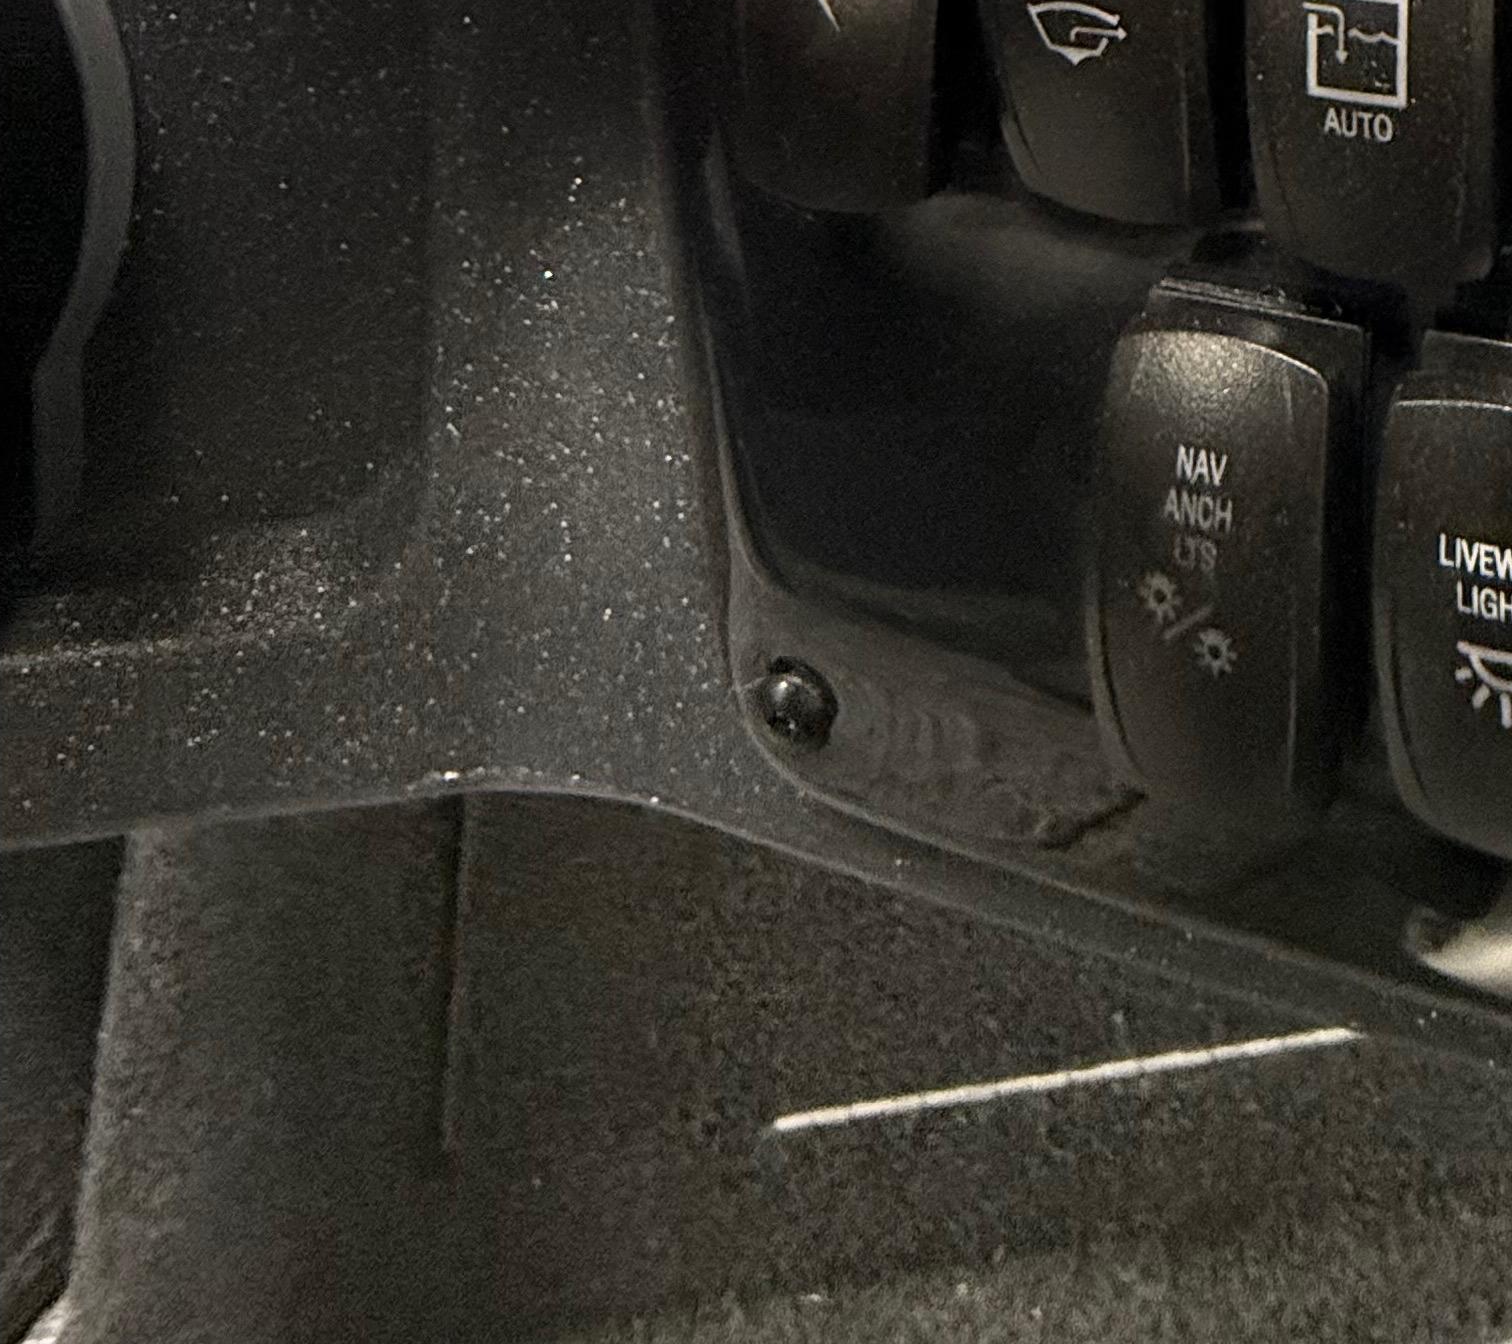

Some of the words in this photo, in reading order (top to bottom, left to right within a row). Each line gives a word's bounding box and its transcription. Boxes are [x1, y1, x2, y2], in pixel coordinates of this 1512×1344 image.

[1324, 107, 1395, 143] AUTO
[1175, 445, 1229, 487] NAV
[1163, 488, 1234, 533] ANCH
